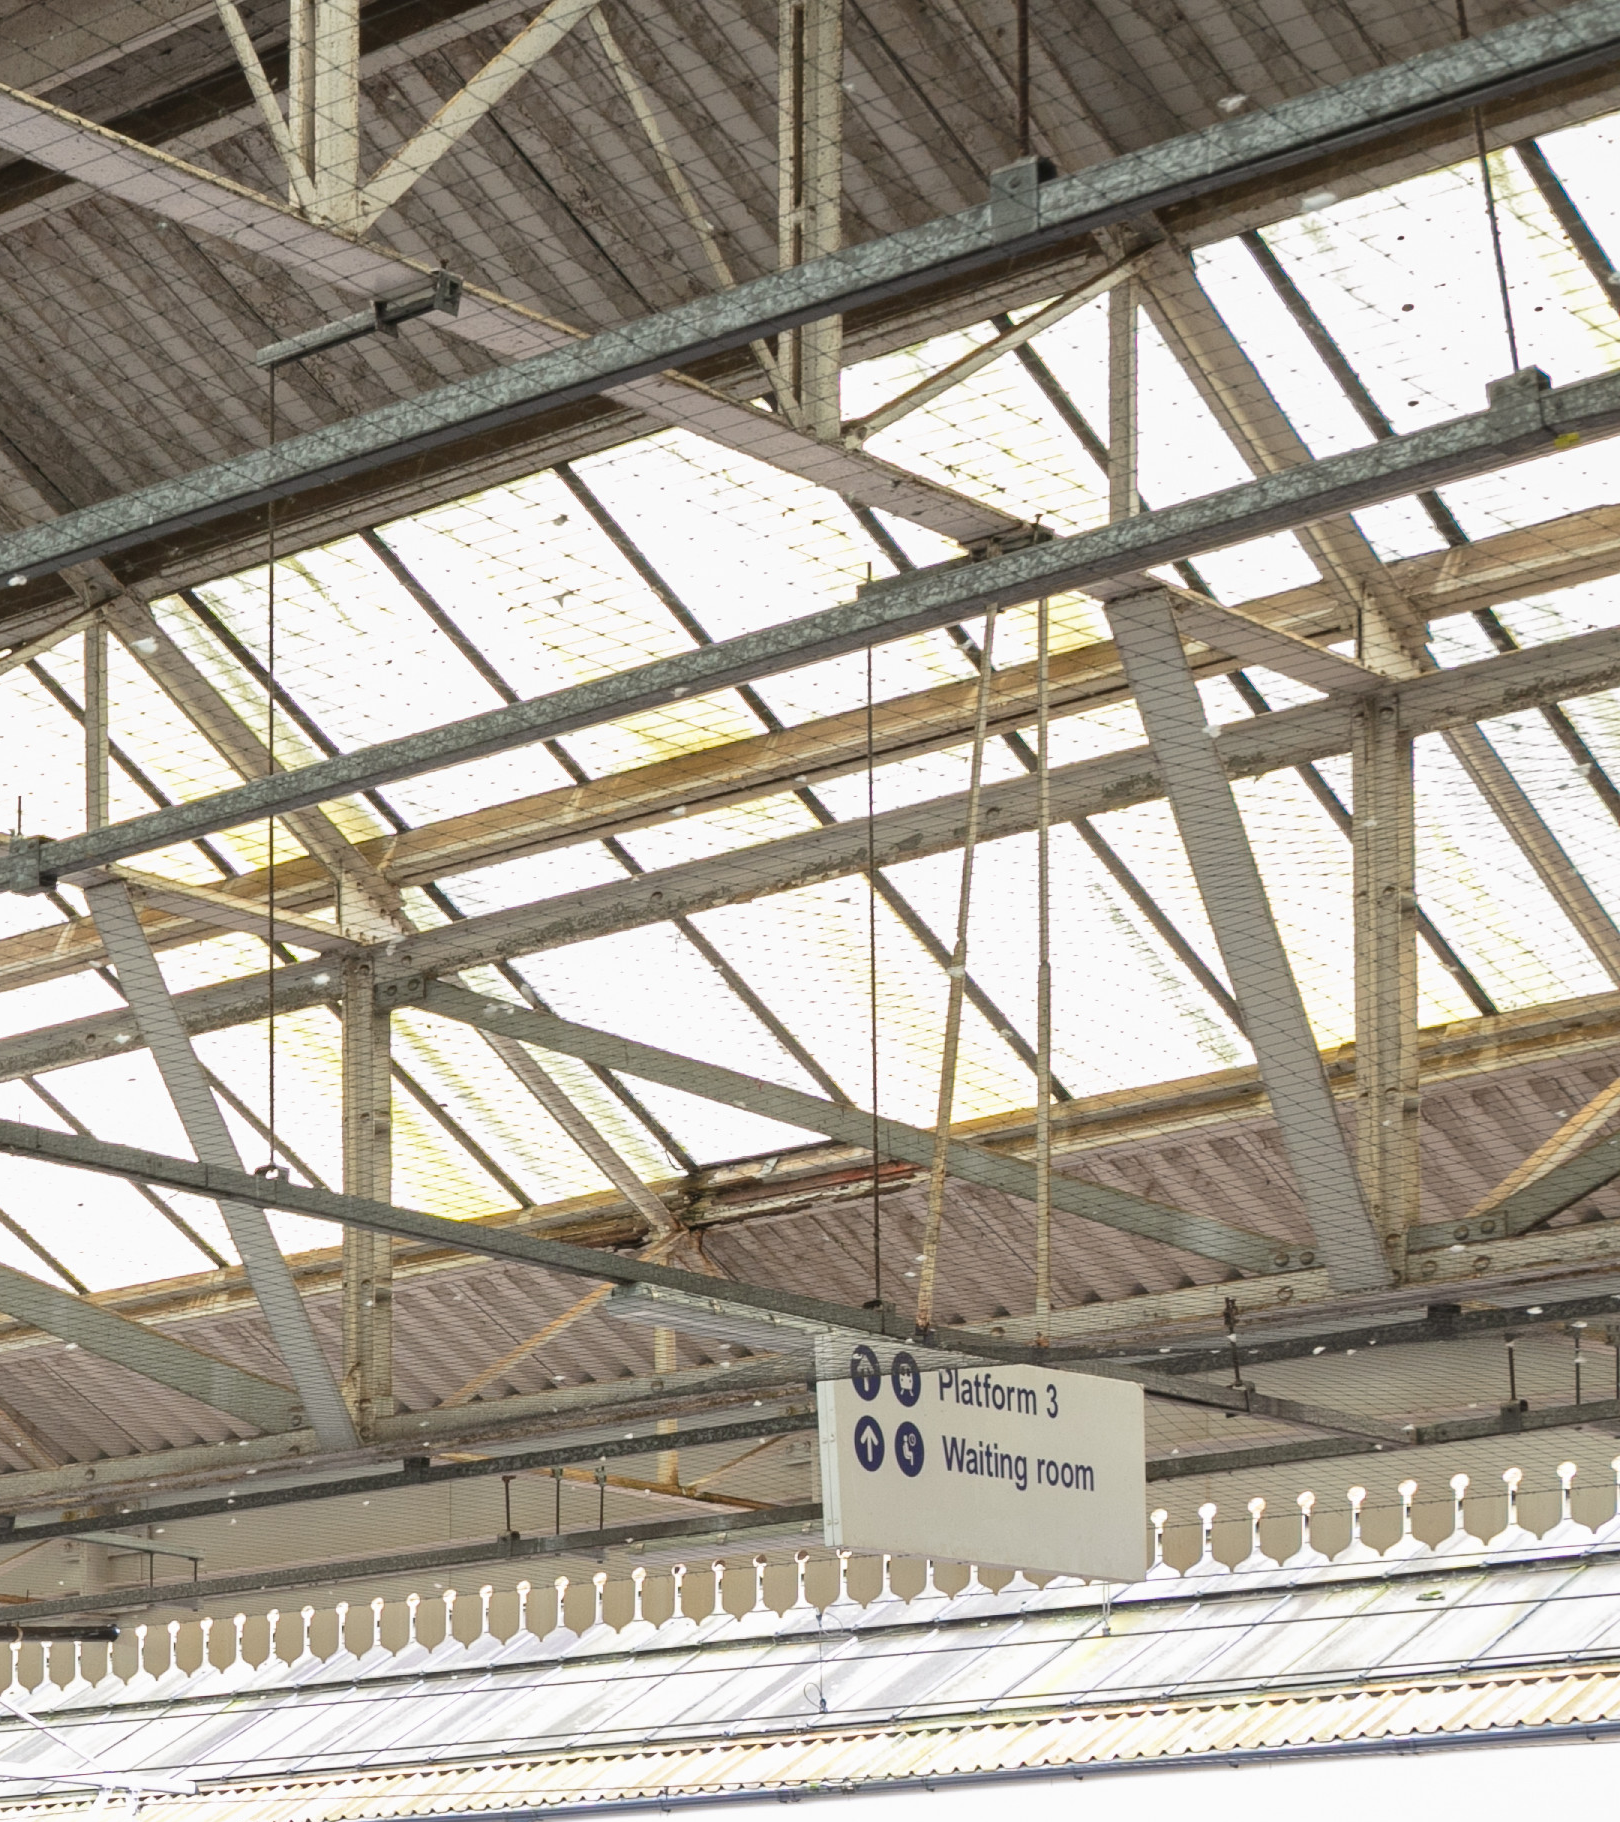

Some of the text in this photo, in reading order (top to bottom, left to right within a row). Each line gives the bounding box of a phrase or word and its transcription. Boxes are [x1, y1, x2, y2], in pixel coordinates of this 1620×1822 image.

[939, 1368, 1059, 1419] Platform 3
[942, 1435, 1095, 1491] Waiting room
